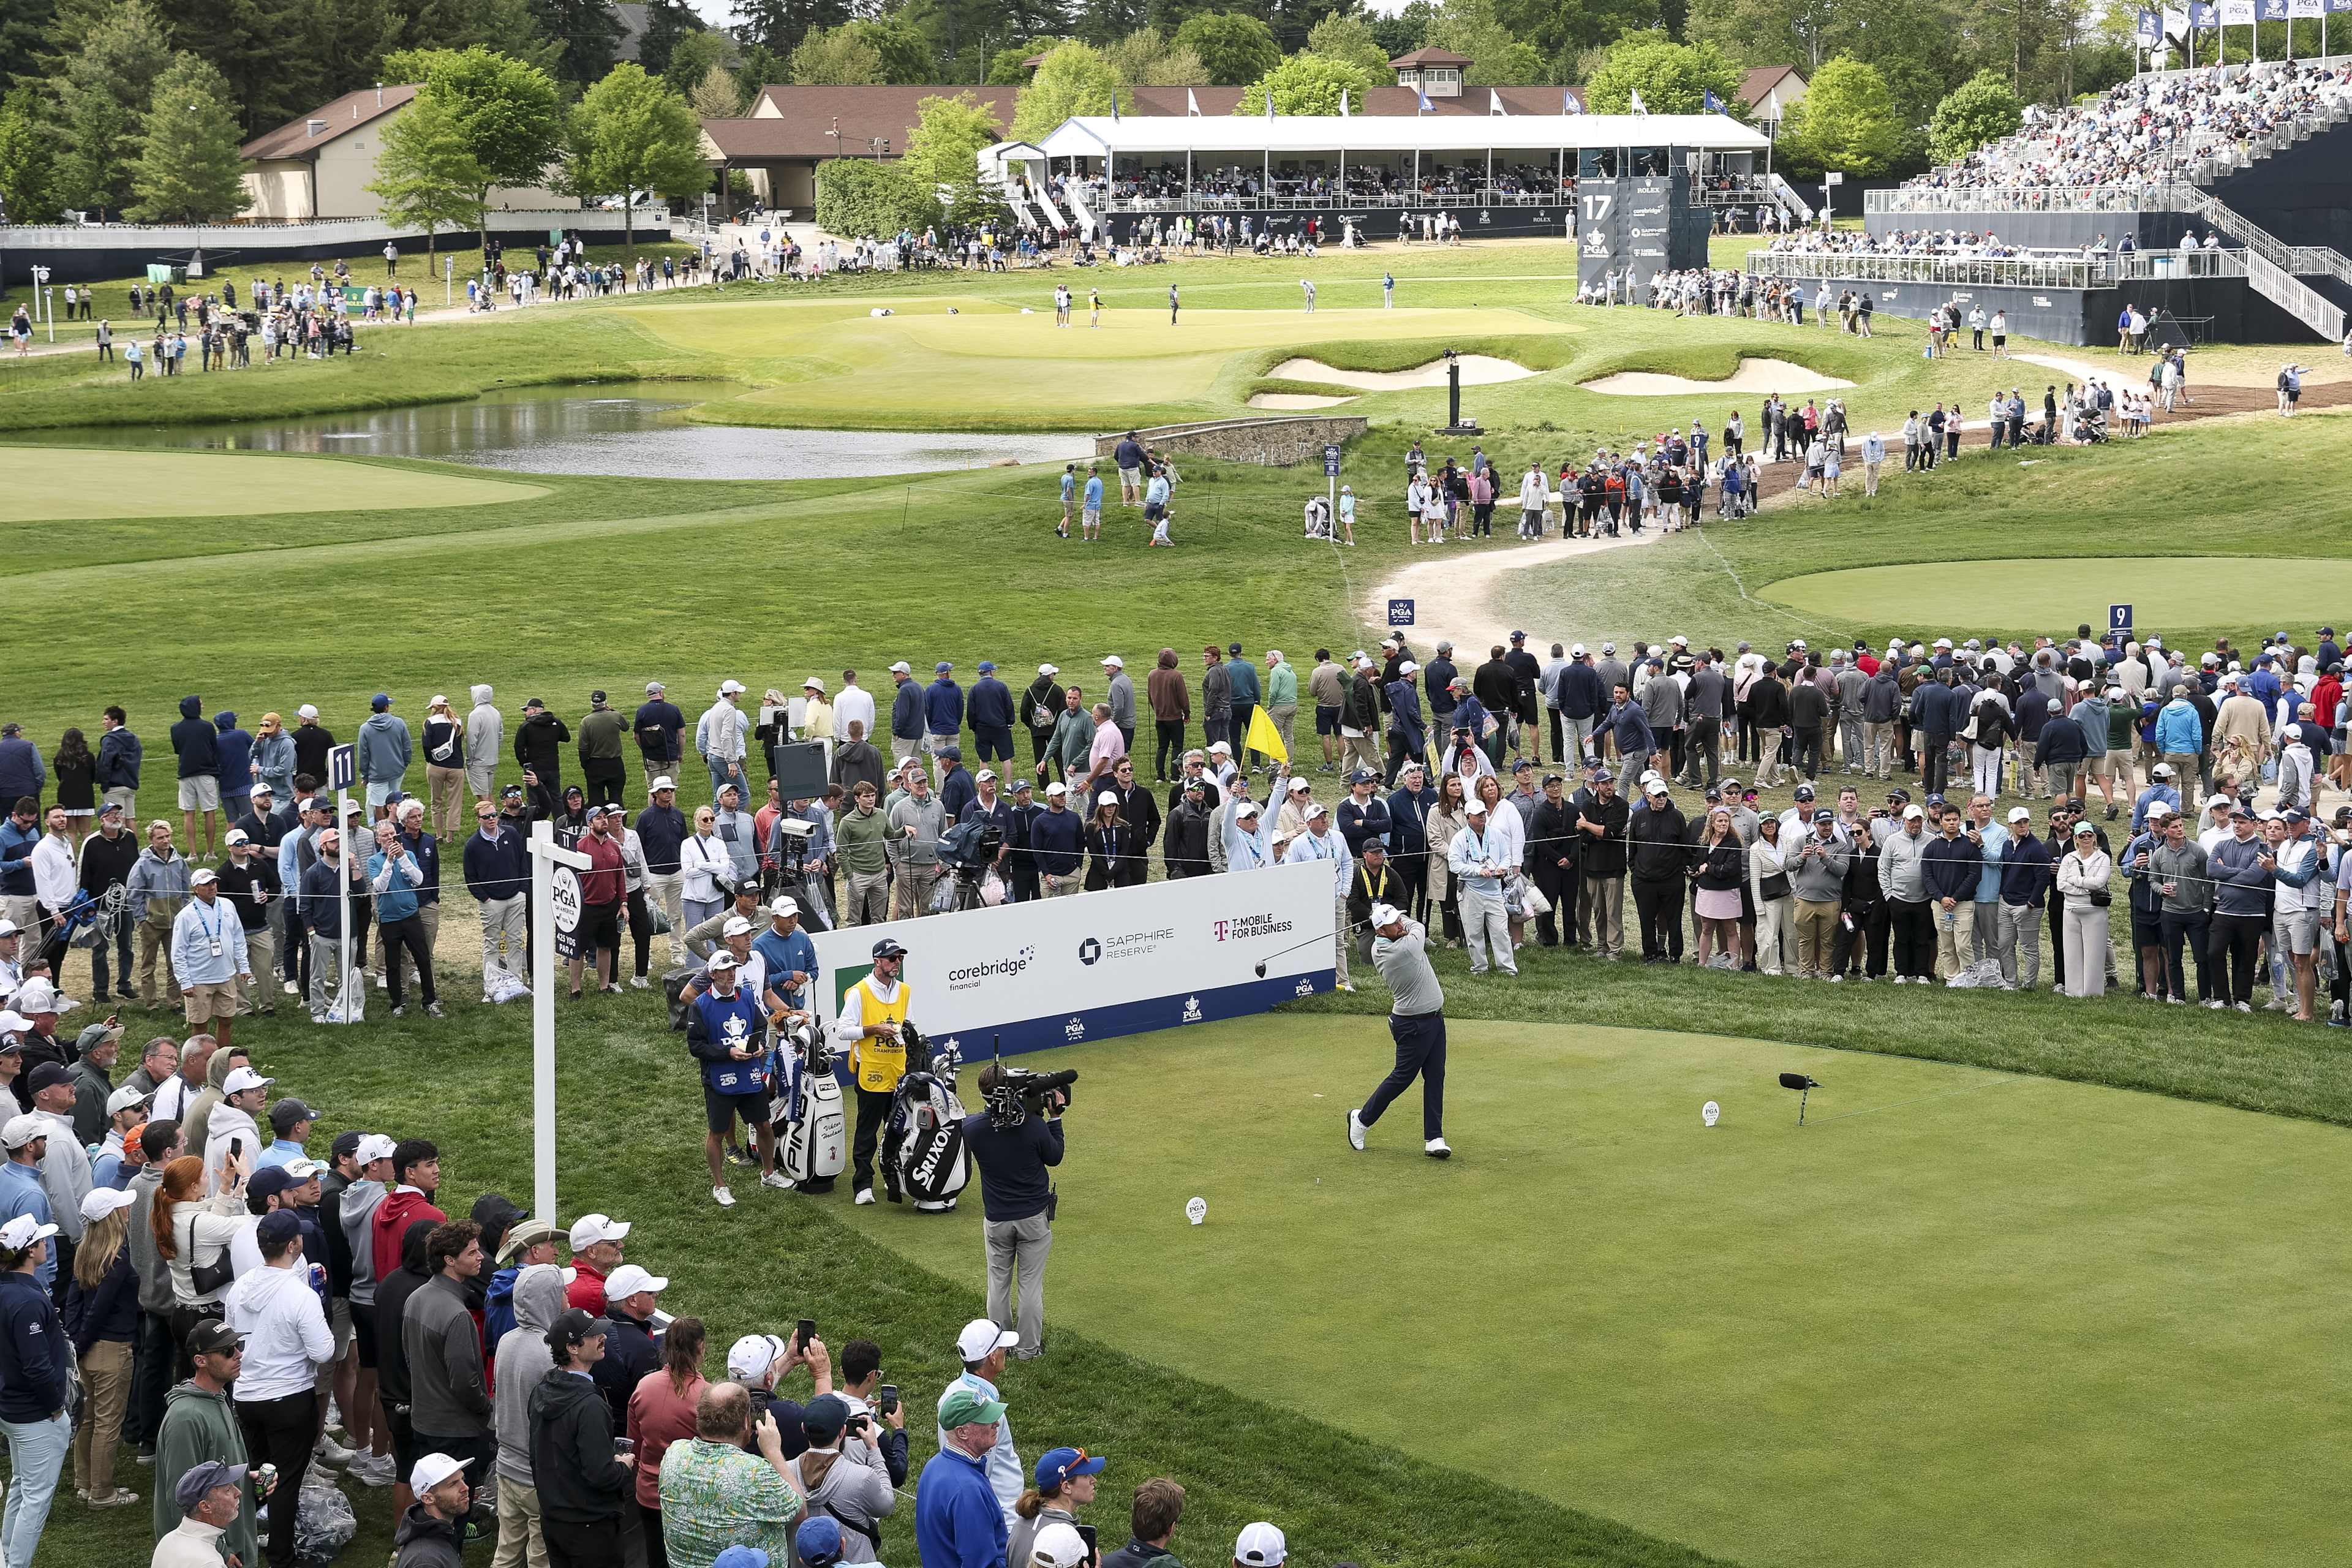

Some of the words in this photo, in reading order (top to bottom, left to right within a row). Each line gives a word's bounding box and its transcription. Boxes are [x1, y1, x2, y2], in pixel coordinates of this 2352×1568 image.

[1583, 195, 1611, 220] 17
[1583, 245, 1609, 254] PGA
[1695, 436, 1700, 446] 9
[2116, 608, 2125, 625] 9
[336, 751, 352, 784] 11
[562, 834, 570, 848] 11
[552, 886, 577, 908] PGA
[560, 907, 574, 915] AMERICA
[1232, 913, 1272, 927] T-MOBILE
[1232, 928, 1251, 940] FOR
[1251, 921, 1292, 937] BUSINESS
[557, 933, 566, 943] 425
[566, 935, 576, 947] YDS
[1107, 928, 1174, 948] SAPPHIRE
[559, 943, 569, 953] PAR
[949, 959, 1026, 982] corebridge
[949, 980, 981, 992] financial
[1295, 984, 1313, 993] PGA
[1183, 1008, 1202, 1019] PGA
[1065, 1023, 1085, 1034] PGA
[720, 1076, 737, 1086] 250
[867, 1074, 883, 1082] 250
[823, 1122, 841, 1132] Viktor
[787, 1095, 808, 1174] PING
[912, 1125, 956, 1192] SRIXON
[1189, 1204, 1204, 1213] PGA
